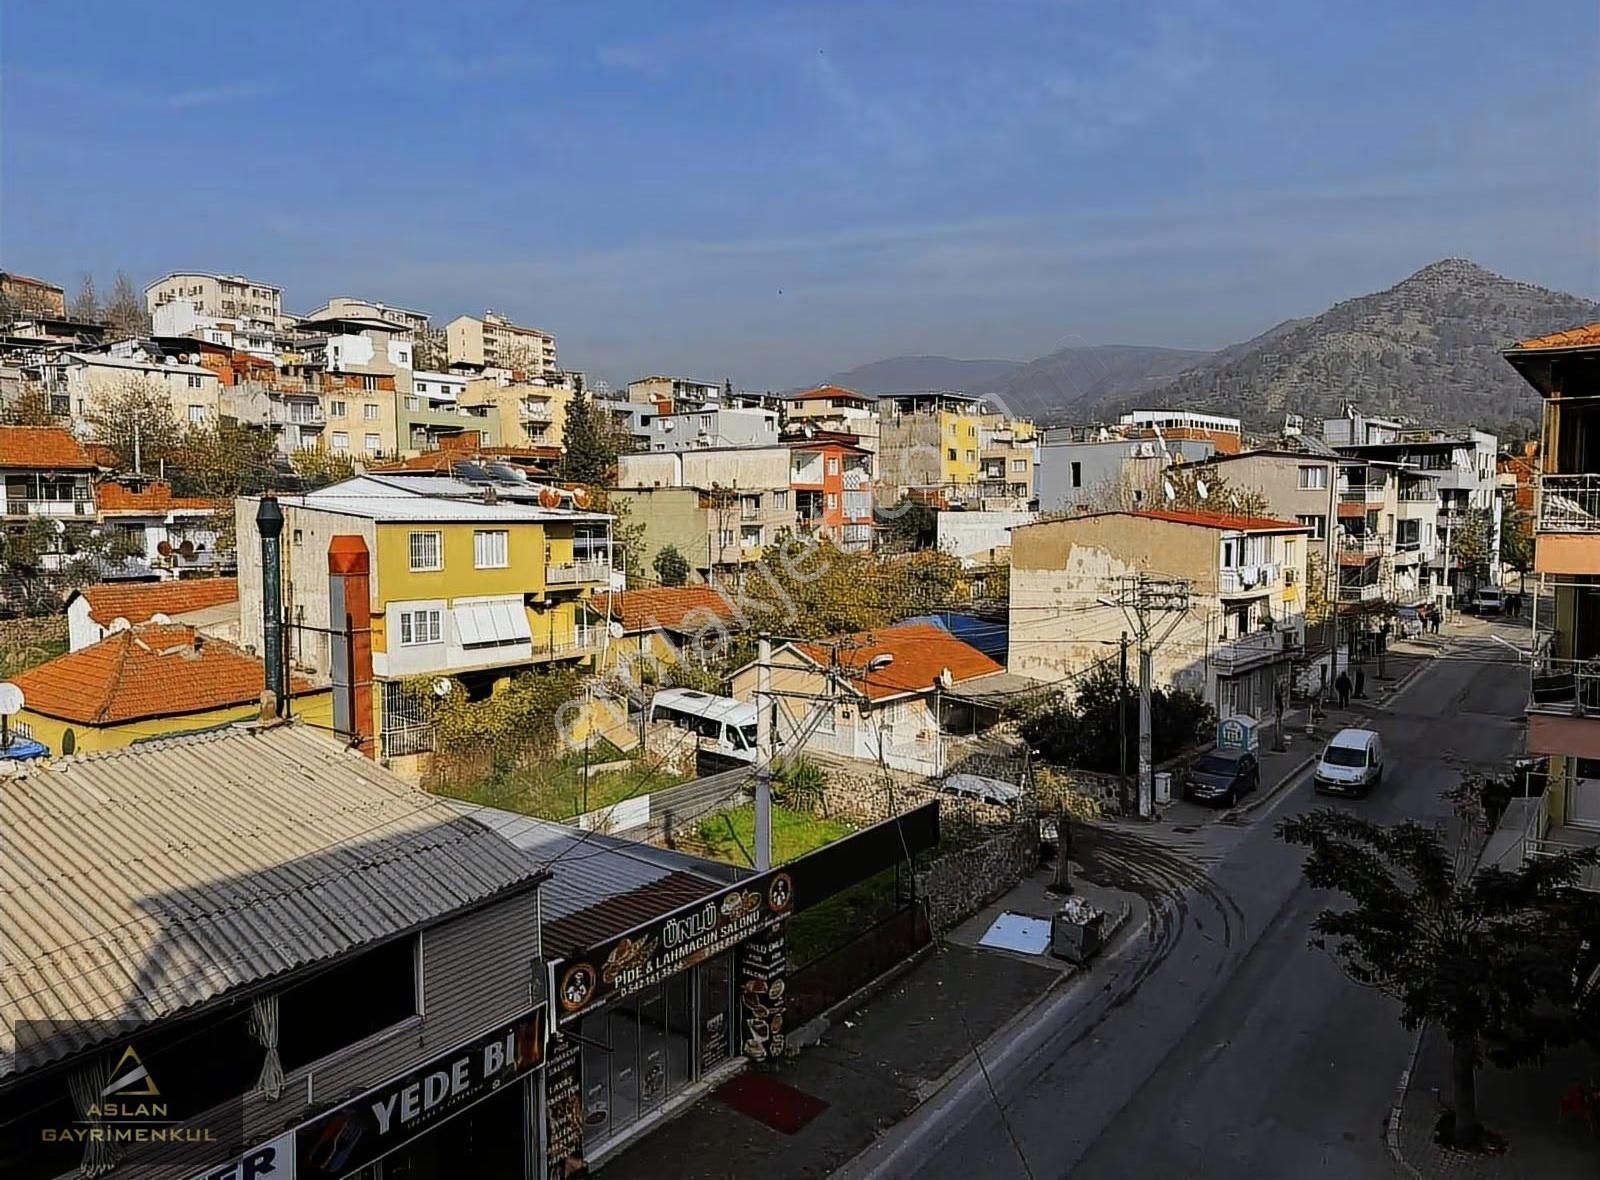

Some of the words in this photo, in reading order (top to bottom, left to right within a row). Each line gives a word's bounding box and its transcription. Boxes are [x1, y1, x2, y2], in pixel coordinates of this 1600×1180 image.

[614, 965, 643, 989] PİDE
[655, 931, 718, 970] LAHMACUN
[720, 910, 760, 937] SALONU
[663, 901, 717, 949] ÜNLÜ
[371, 1056, 471, 1136] YEDE
